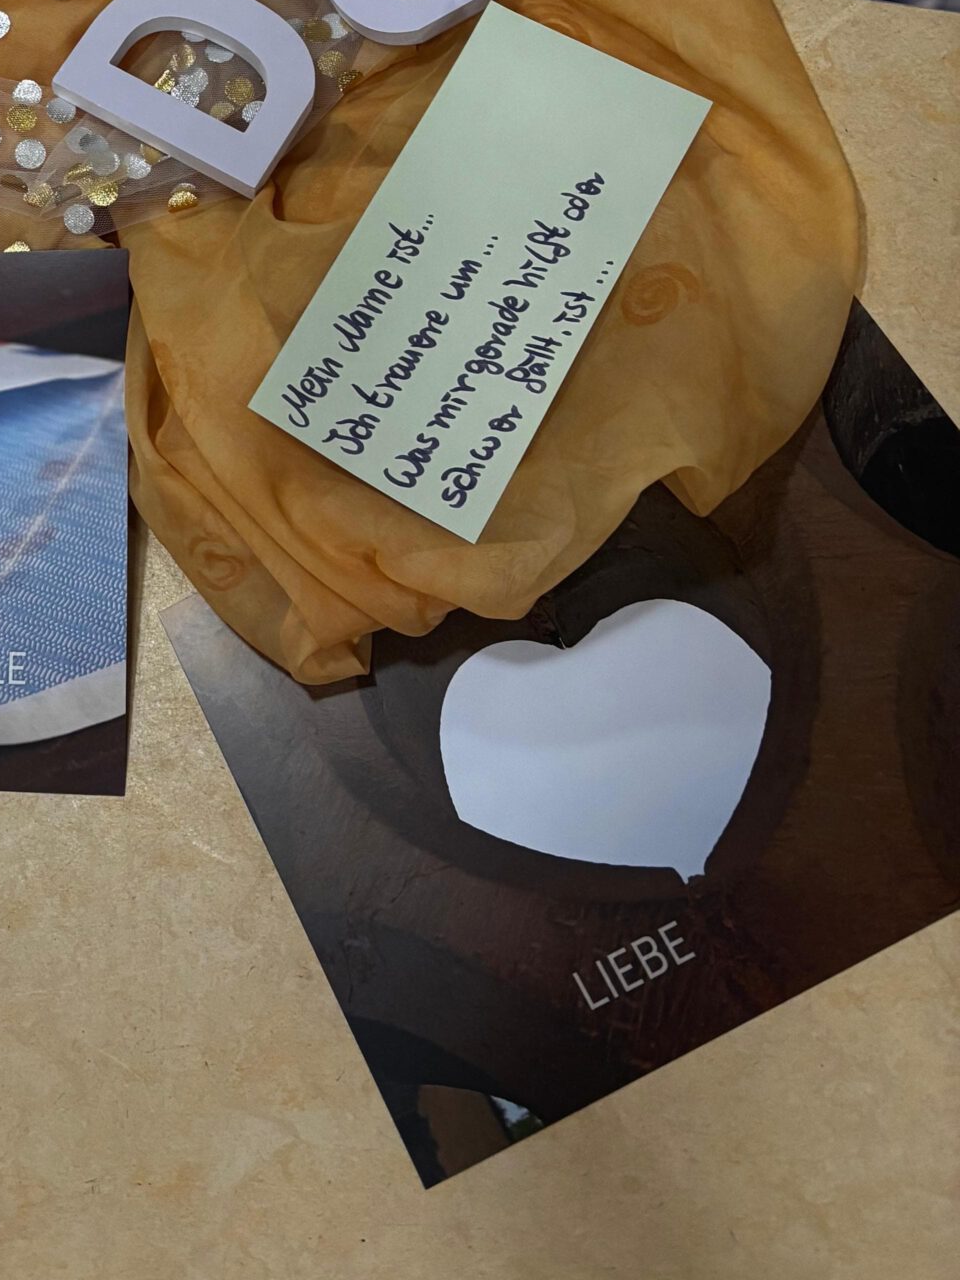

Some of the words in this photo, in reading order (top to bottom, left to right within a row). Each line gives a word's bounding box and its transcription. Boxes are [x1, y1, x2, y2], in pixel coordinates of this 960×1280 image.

[280, 356, 344, 428] Mein
[333, 268, 404, 353] Name
[322, 410, 381, 455] Ich
[383, 432, 440, 488] Was
[572, 920, 697, 1011] LIEBE
